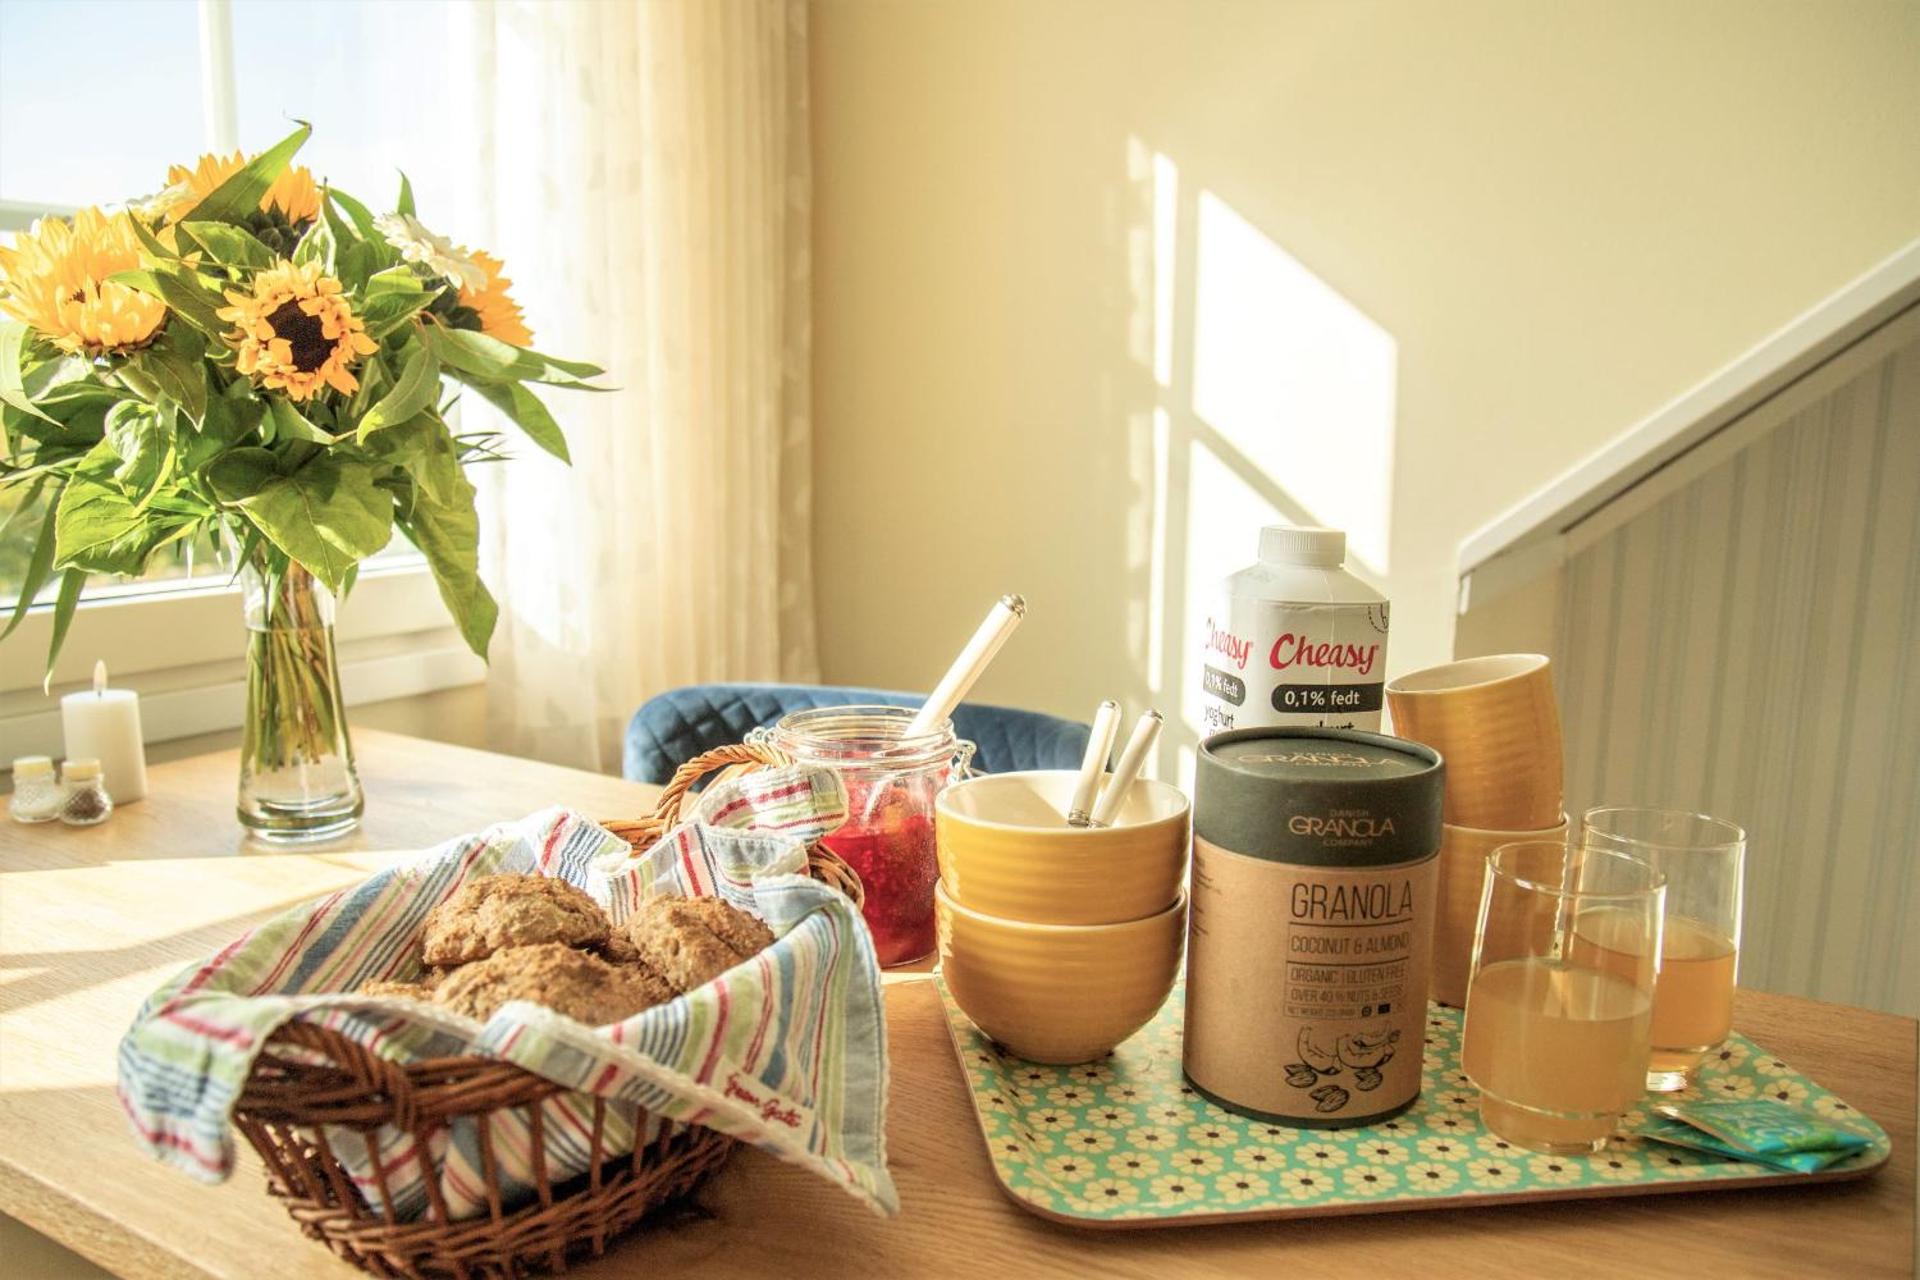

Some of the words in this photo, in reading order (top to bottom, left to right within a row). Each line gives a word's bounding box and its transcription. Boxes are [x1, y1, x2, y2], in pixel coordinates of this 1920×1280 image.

[1269, 633, 1375, 675] Cheasy
[1284, 690, 1325, 707] 0,1%
[1330, 690, 1360, 705] fedt
[1204, 704, 1234, 729] yoghurt
[1329, 809, 1369, 817] DANISH
[1289, 815, 1395, 838] GRANOLA
[1291, 880, 1412, 920] GRANOLA
[1291, 935, 1350, 954] COCONUT
[1353, 938, 1362, 955] &
[1366, 931, 1410, 953] ALMOND
[1291, 967, 1338, 984] ORGANIC
[1291, 988, 1319, 1002] OVER
